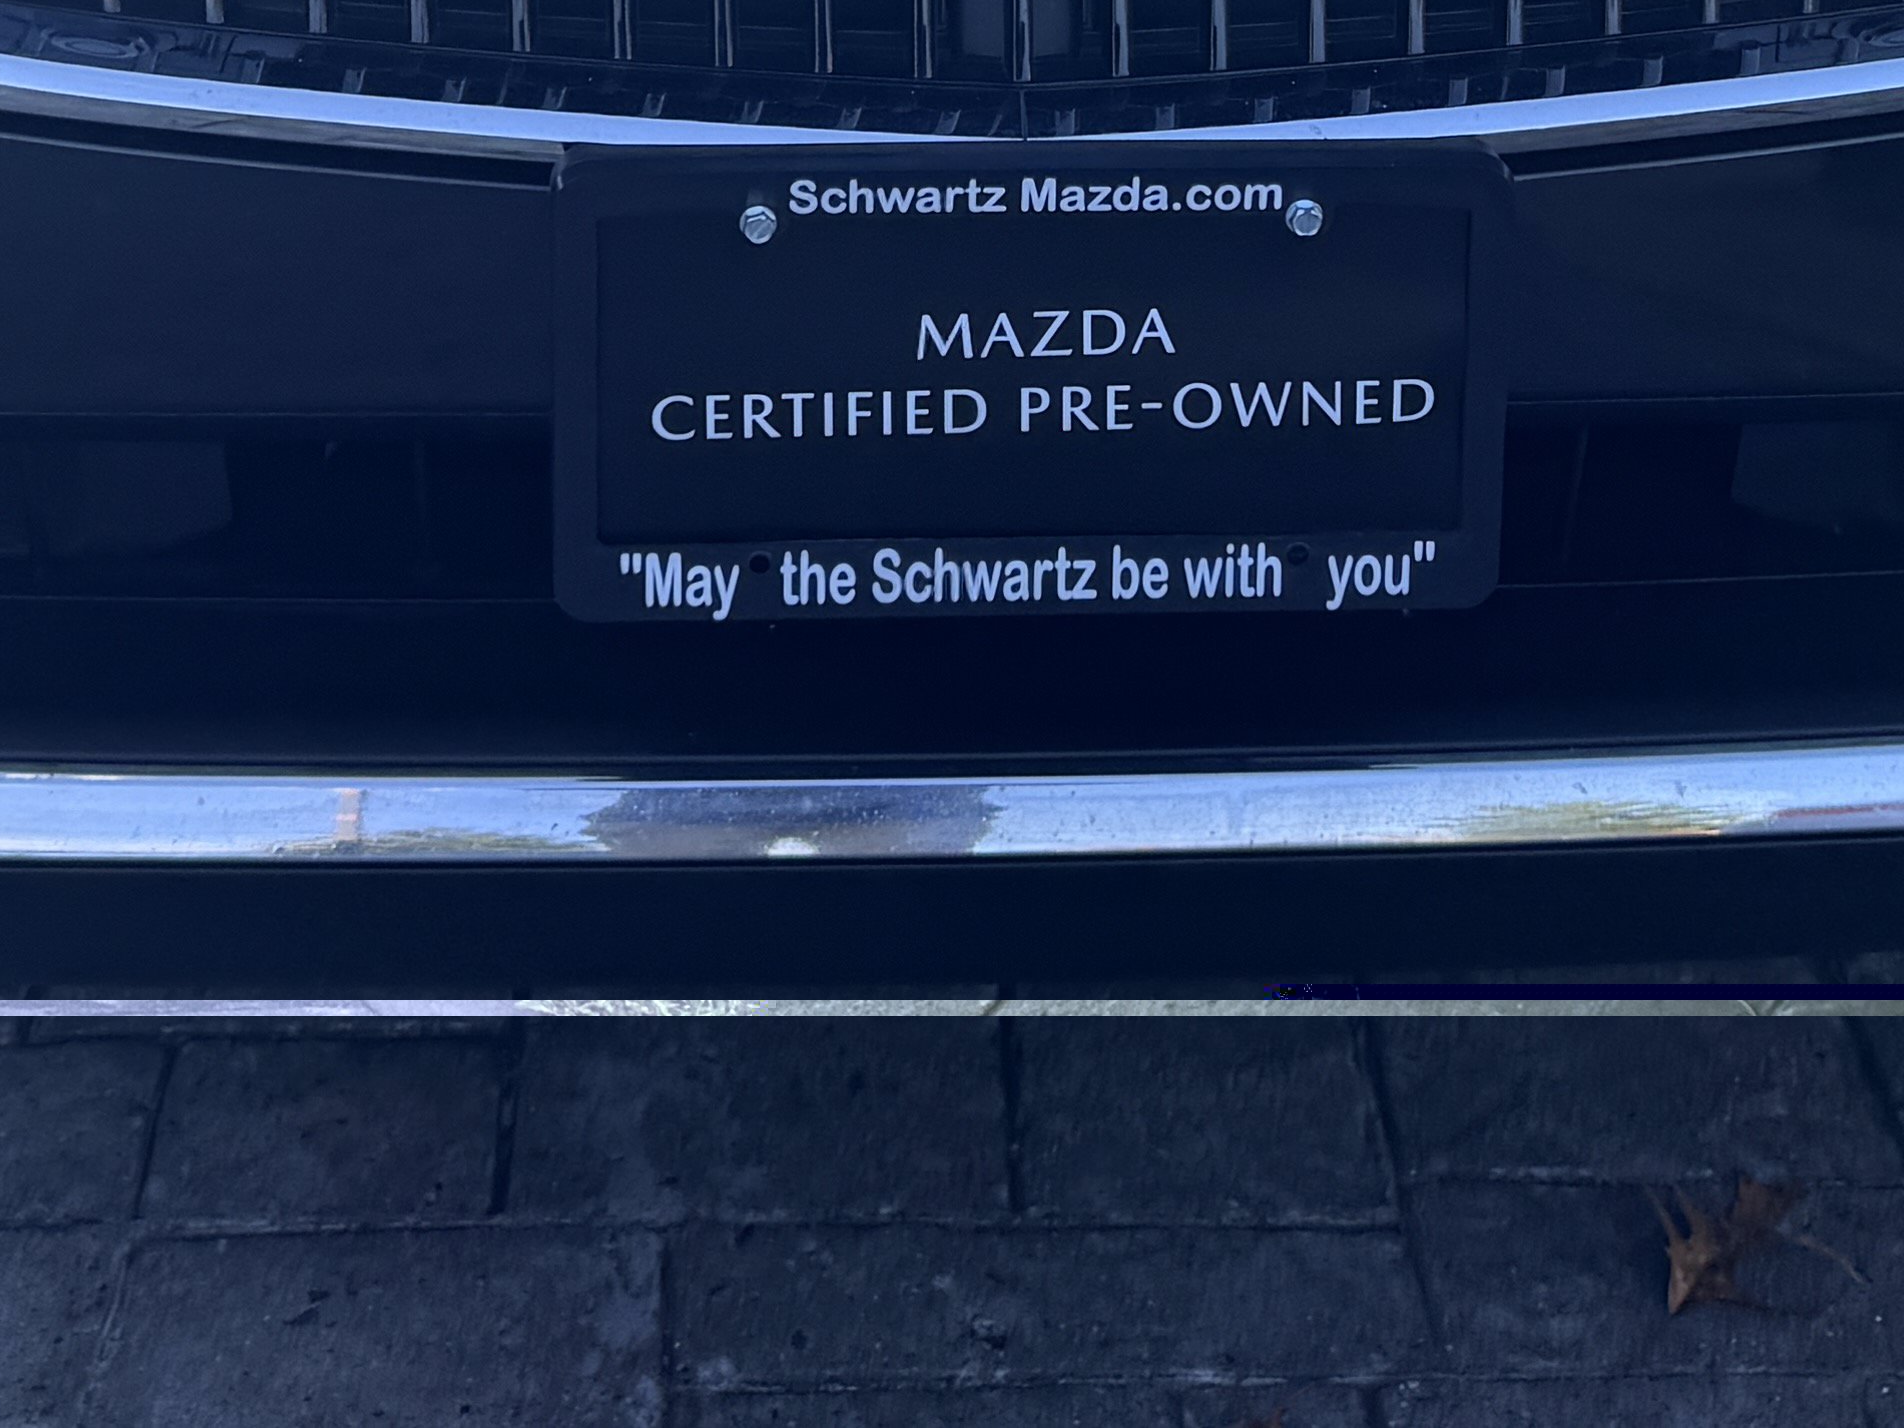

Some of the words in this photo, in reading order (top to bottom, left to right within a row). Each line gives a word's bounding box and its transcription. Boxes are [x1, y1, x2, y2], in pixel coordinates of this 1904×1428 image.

[789, 178, 1007, 215] Schwartz
[1020, 176, 1283, 213] Mazda.com
[916, 308, 1176, 361] MAZDA
[651, 389, 987, 441] CERTIFIED
[1020, 378, 1435, 432] PRE-OWNED
[620, 551, 740, 621] "May
[779, 549, 856, 605] the
[872, 546, 1098, 604] Schwartz
[1112, 544, 1169, 600] be
[1183, 542, 1282, 599] with
[1326, 540, 1436, 611] you"
